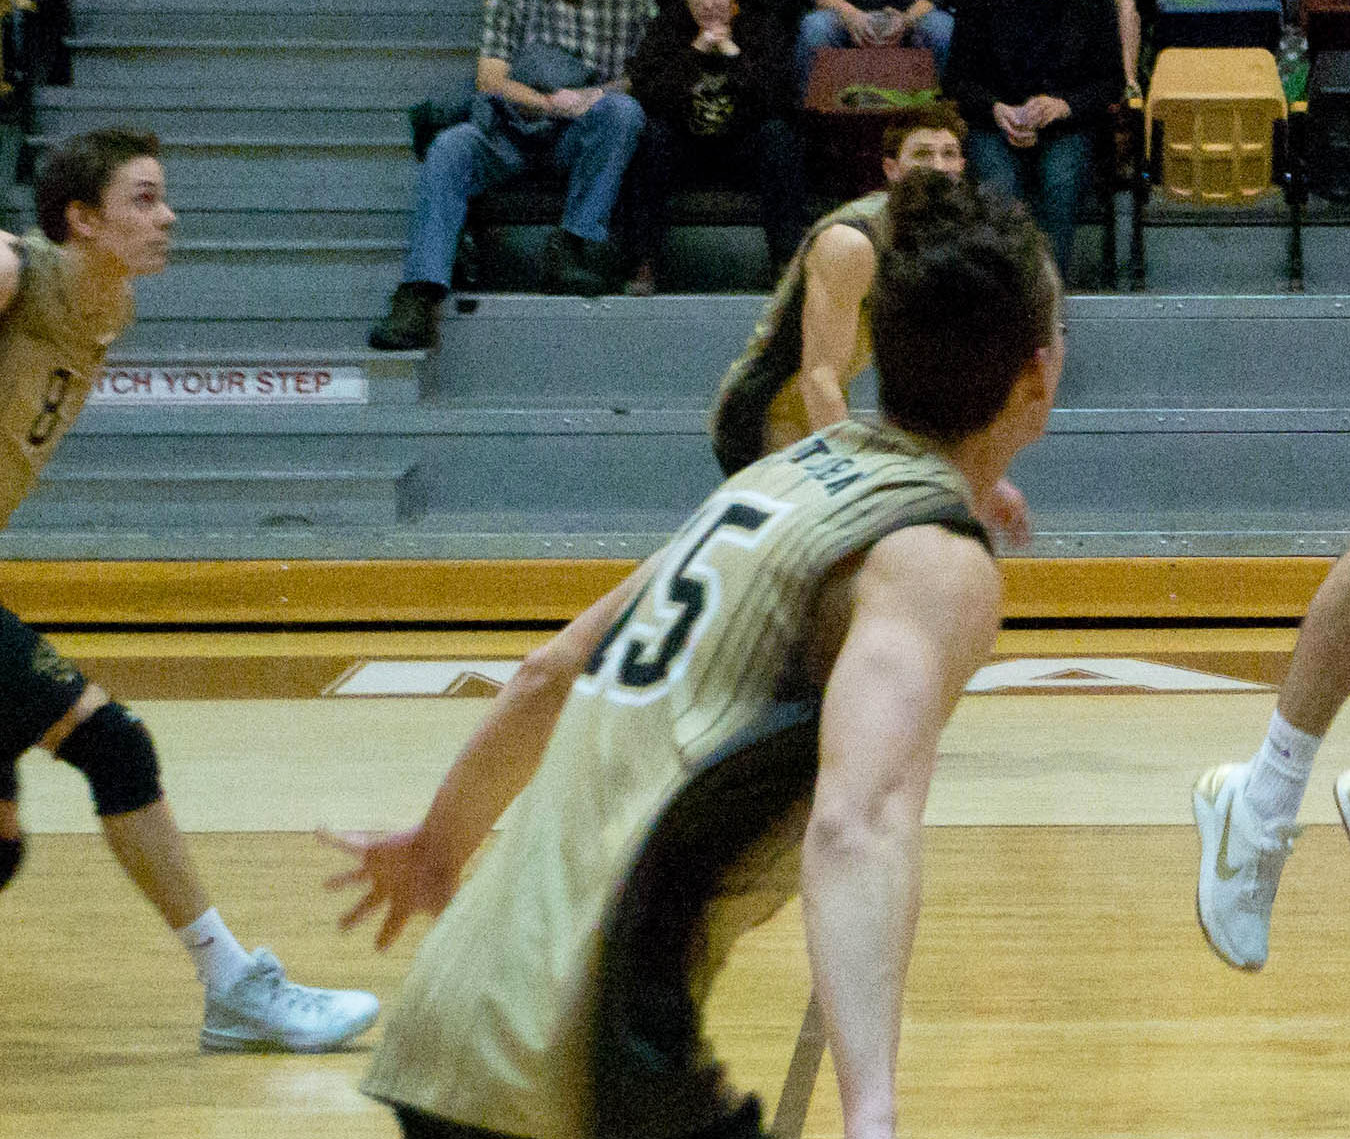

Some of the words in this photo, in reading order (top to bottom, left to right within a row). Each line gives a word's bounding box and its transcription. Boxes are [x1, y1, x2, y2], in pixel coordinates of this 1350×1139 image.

[27, 367, 70, 445] 8
[96, 370, 151, 394] TCH
[163, 370, 246, 394] YOUR
[256, 370, 332, 394] STEP
